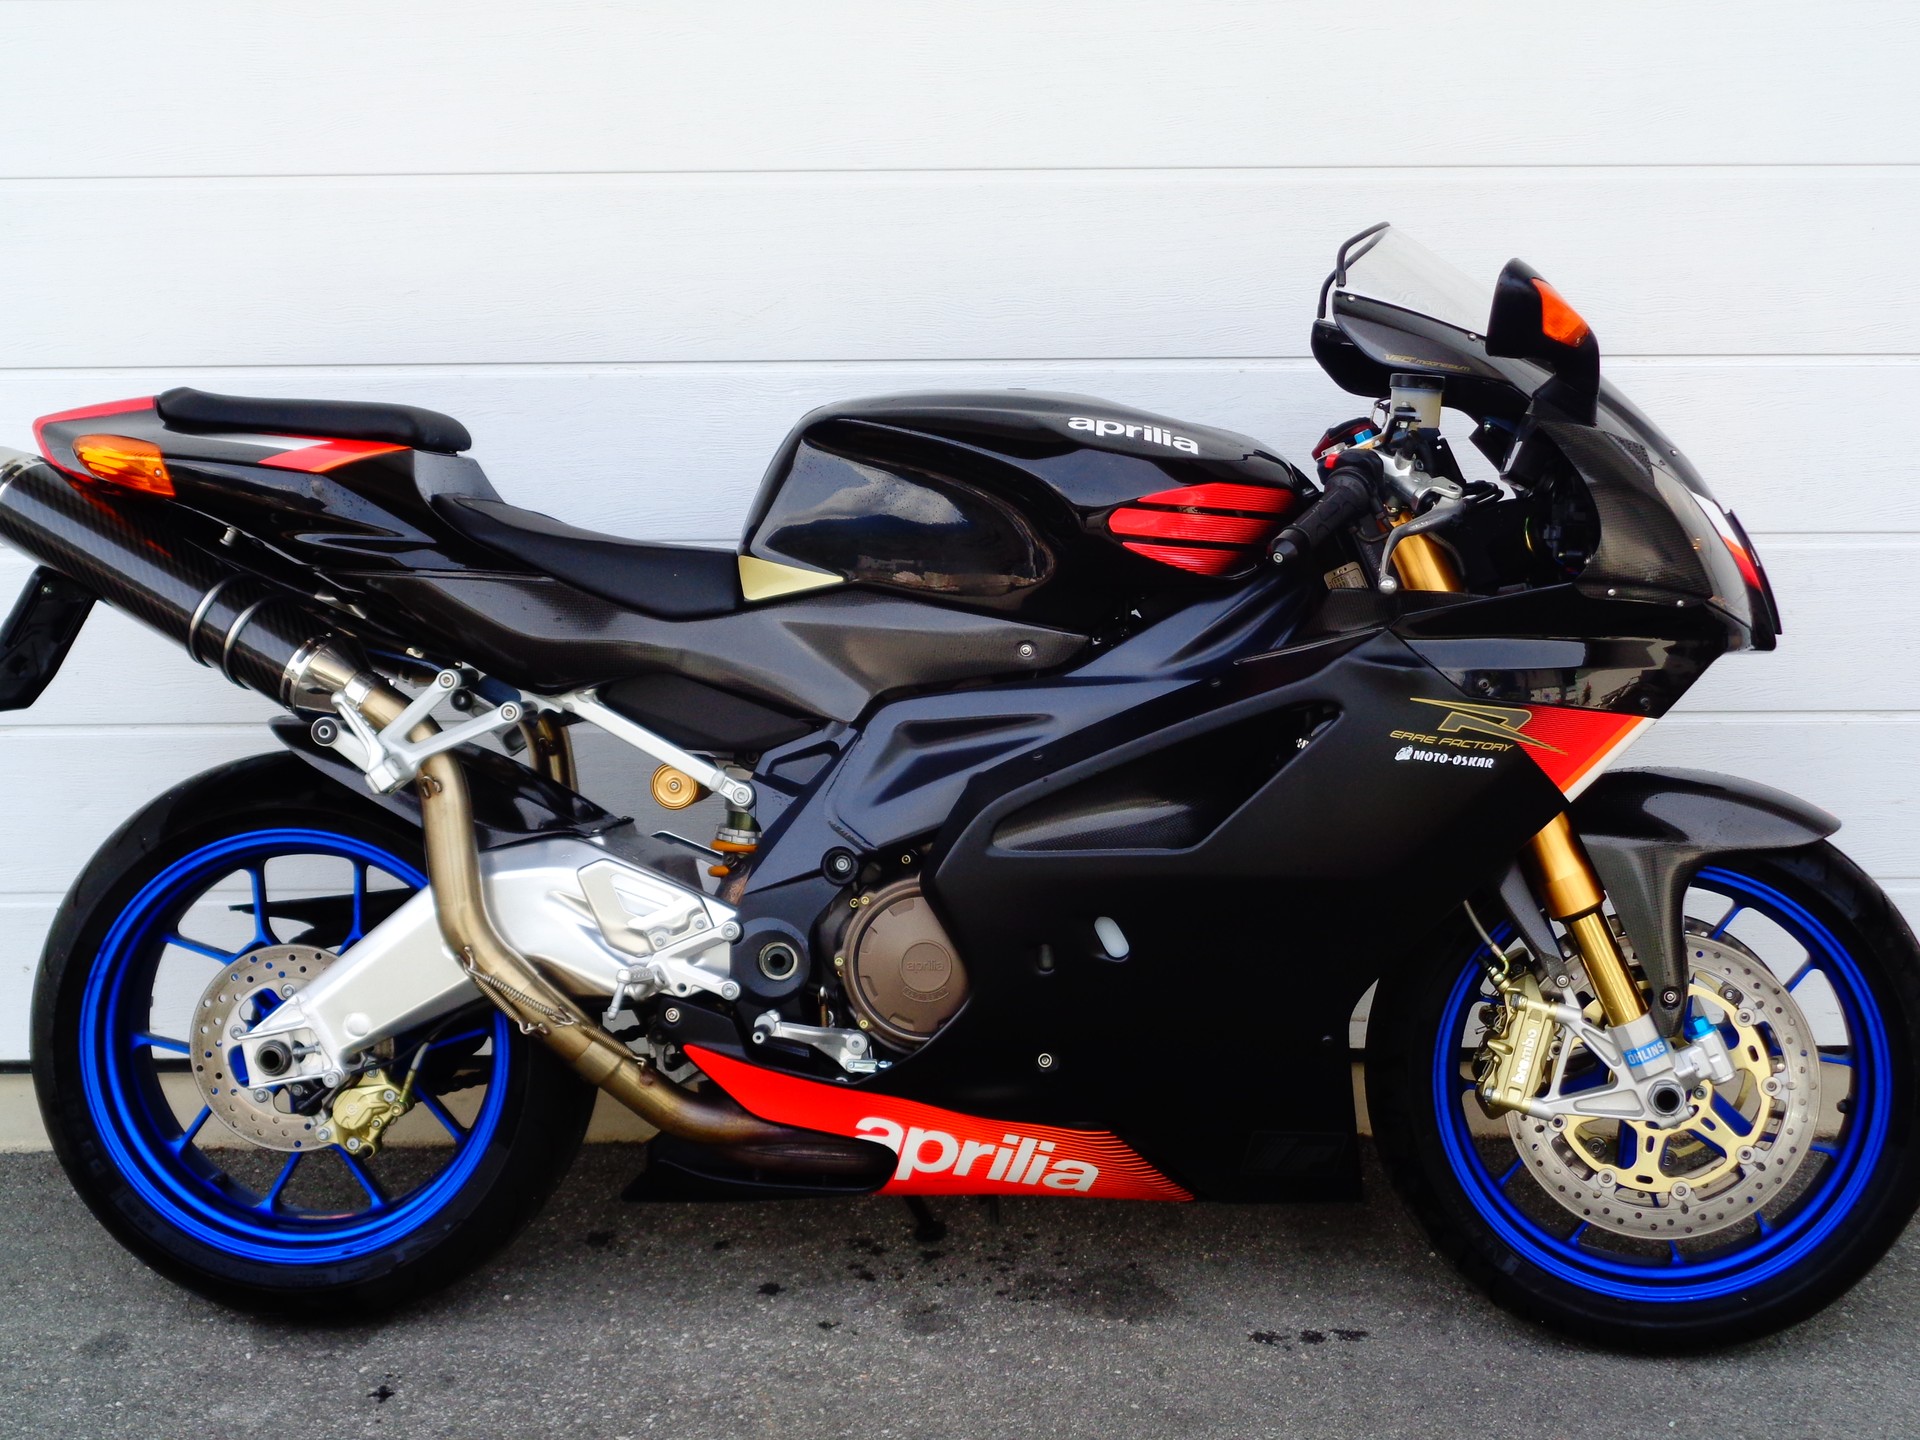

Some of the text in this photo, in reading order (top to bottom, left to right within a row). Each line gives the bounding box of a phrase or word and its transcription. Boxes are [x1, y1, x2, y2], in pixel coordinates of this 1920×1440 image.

[1067, 416, 1199, 455] aprilia
[1389, 729, 1514, 752] ERRE FACTORY
[1412, 750, 1495, 769] MOTO-OSKAR
[906, 959, 945, 974] aprilia
[1511, 1029, 1537, 1084] brembo
[1627, 1041, 1667, 1065] ÖHLINS
